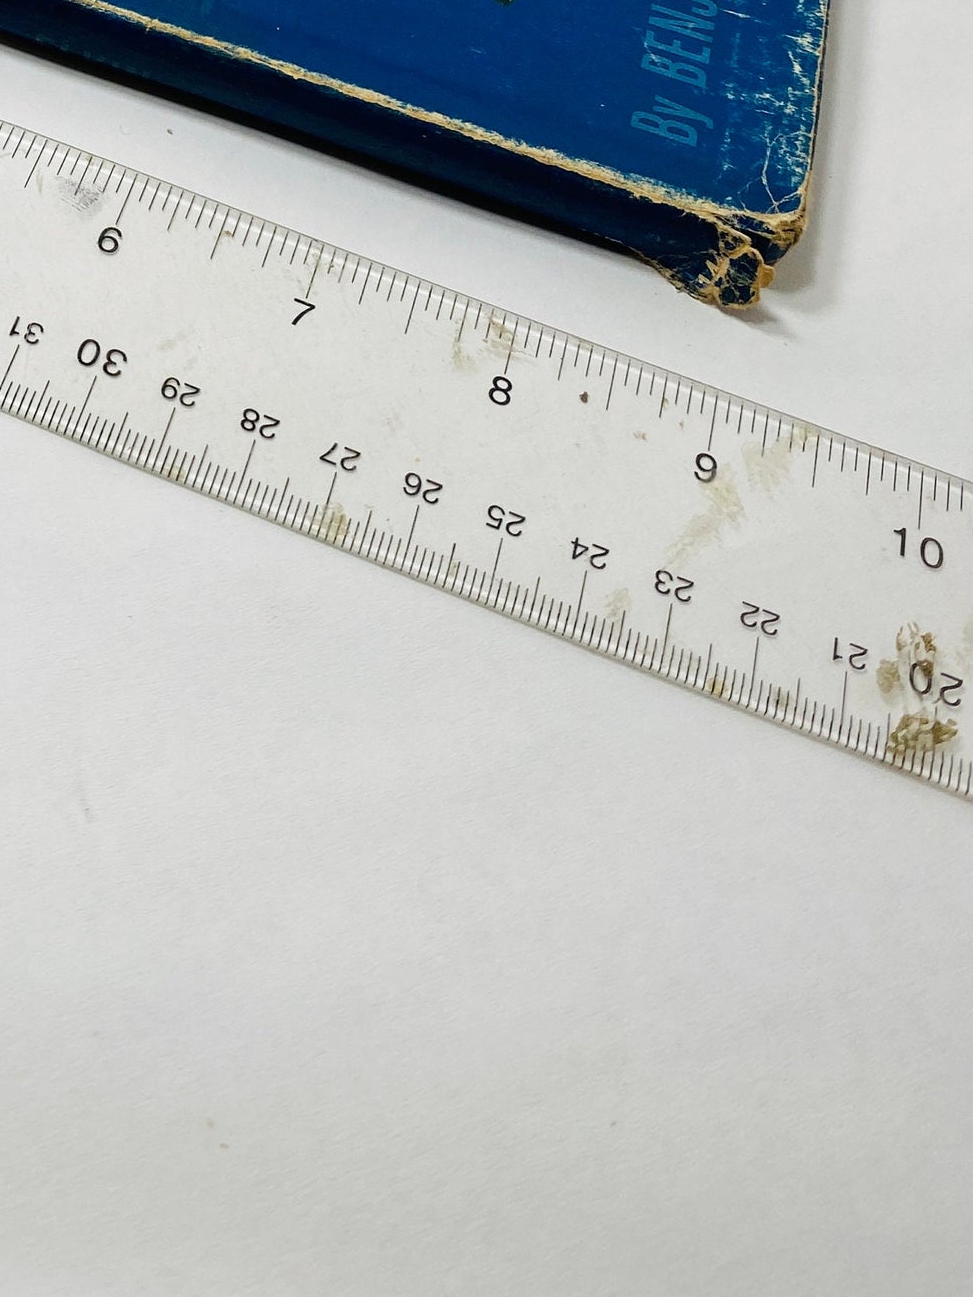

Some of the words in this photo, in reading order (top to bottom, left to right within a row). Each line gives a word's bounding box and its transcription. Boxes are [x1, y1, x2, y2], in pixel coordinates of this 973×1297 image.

[630, 94, 715, 148] By
[96, 226, 123, 254] 6
[290, 296, 317, 327] 7
[8, 315, 45, 346] 31
[75, 338, 128, 378] 30
[159, 376, 202, 408] 29
[487, 375, 514, 407] 8
[239, 407, 282, 440] 28
[318, 441, 362, 472] 27
[693, 452, 718, 483] 9
[402, 471, 444, 505] 26
[484, 504, 527, 538] 25
[569, 536, 611, 570] 24
[893, 526, 945, 570] 10
[653, 568, 695, 603] 23
[739, 600, 782, 637] 22
[832, 636, 869, 671] 21
[908, 659, 964, 707] 20
